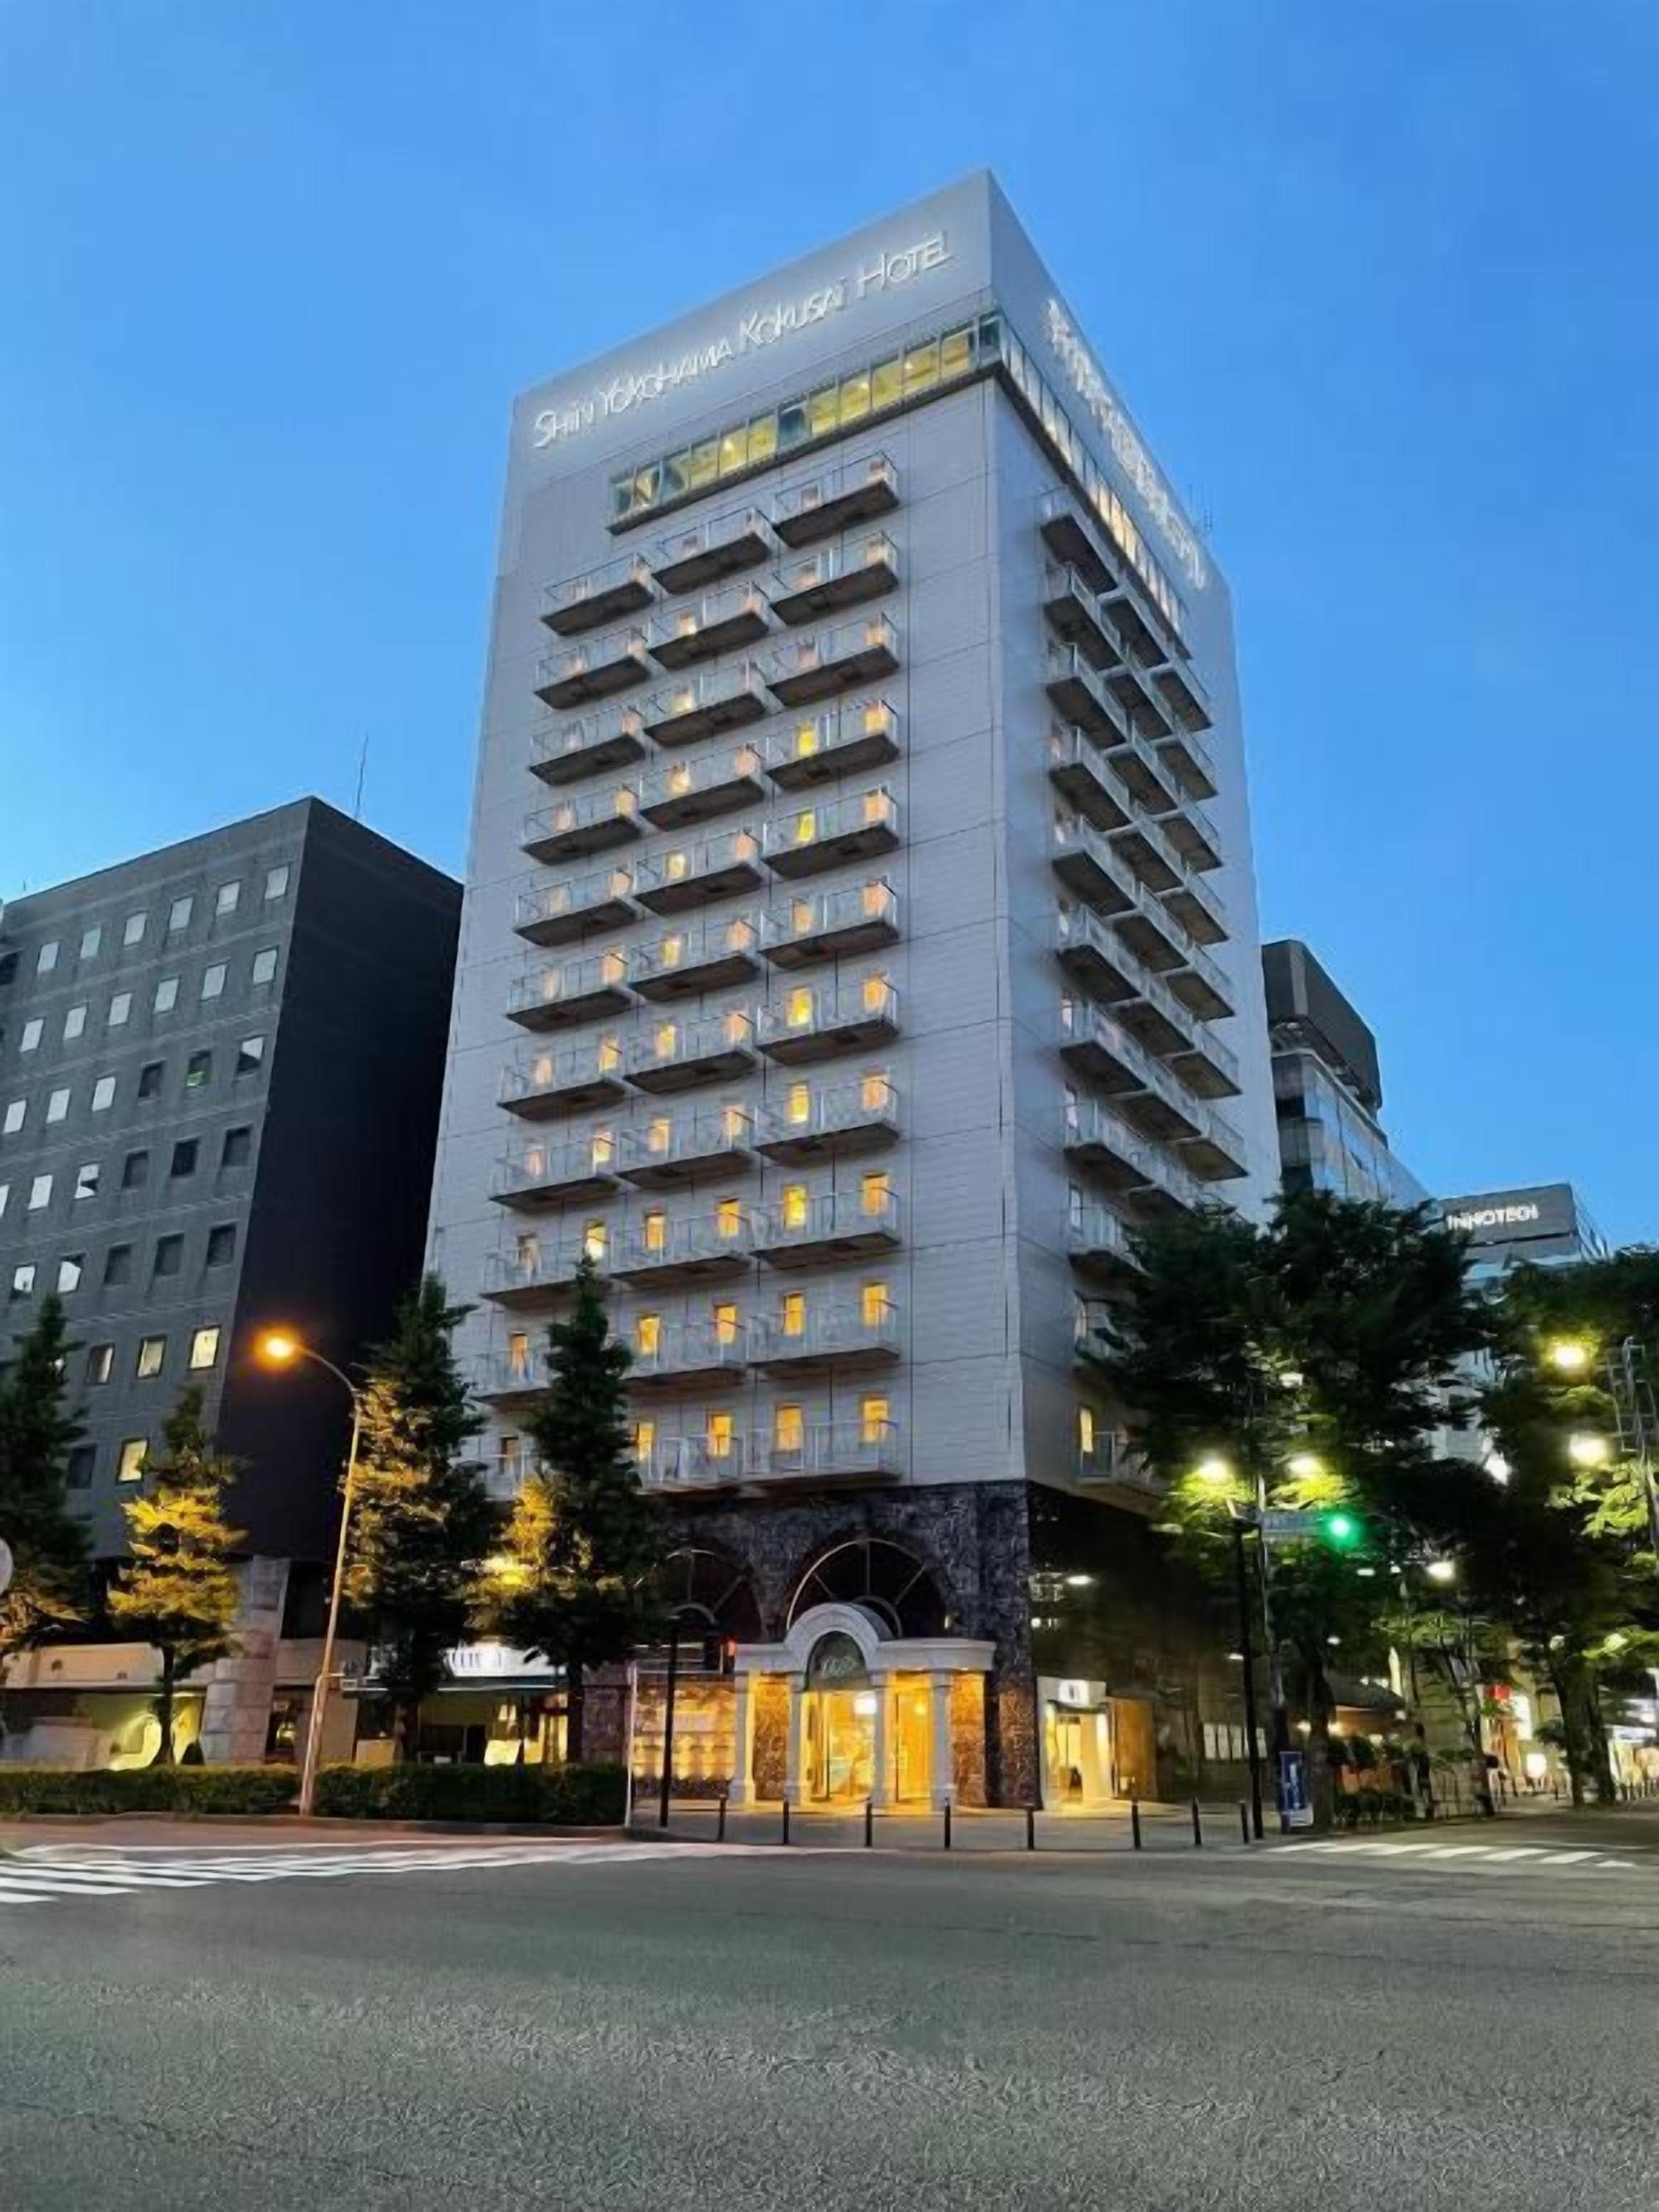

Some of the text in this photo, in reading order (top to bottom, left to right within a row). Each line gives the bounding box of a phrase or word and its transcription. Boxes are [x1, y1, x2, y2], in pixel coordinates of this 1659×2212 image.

[531, 230, 954, 448] SHIN YOKOHAMA KOKUSAI HOTEL
